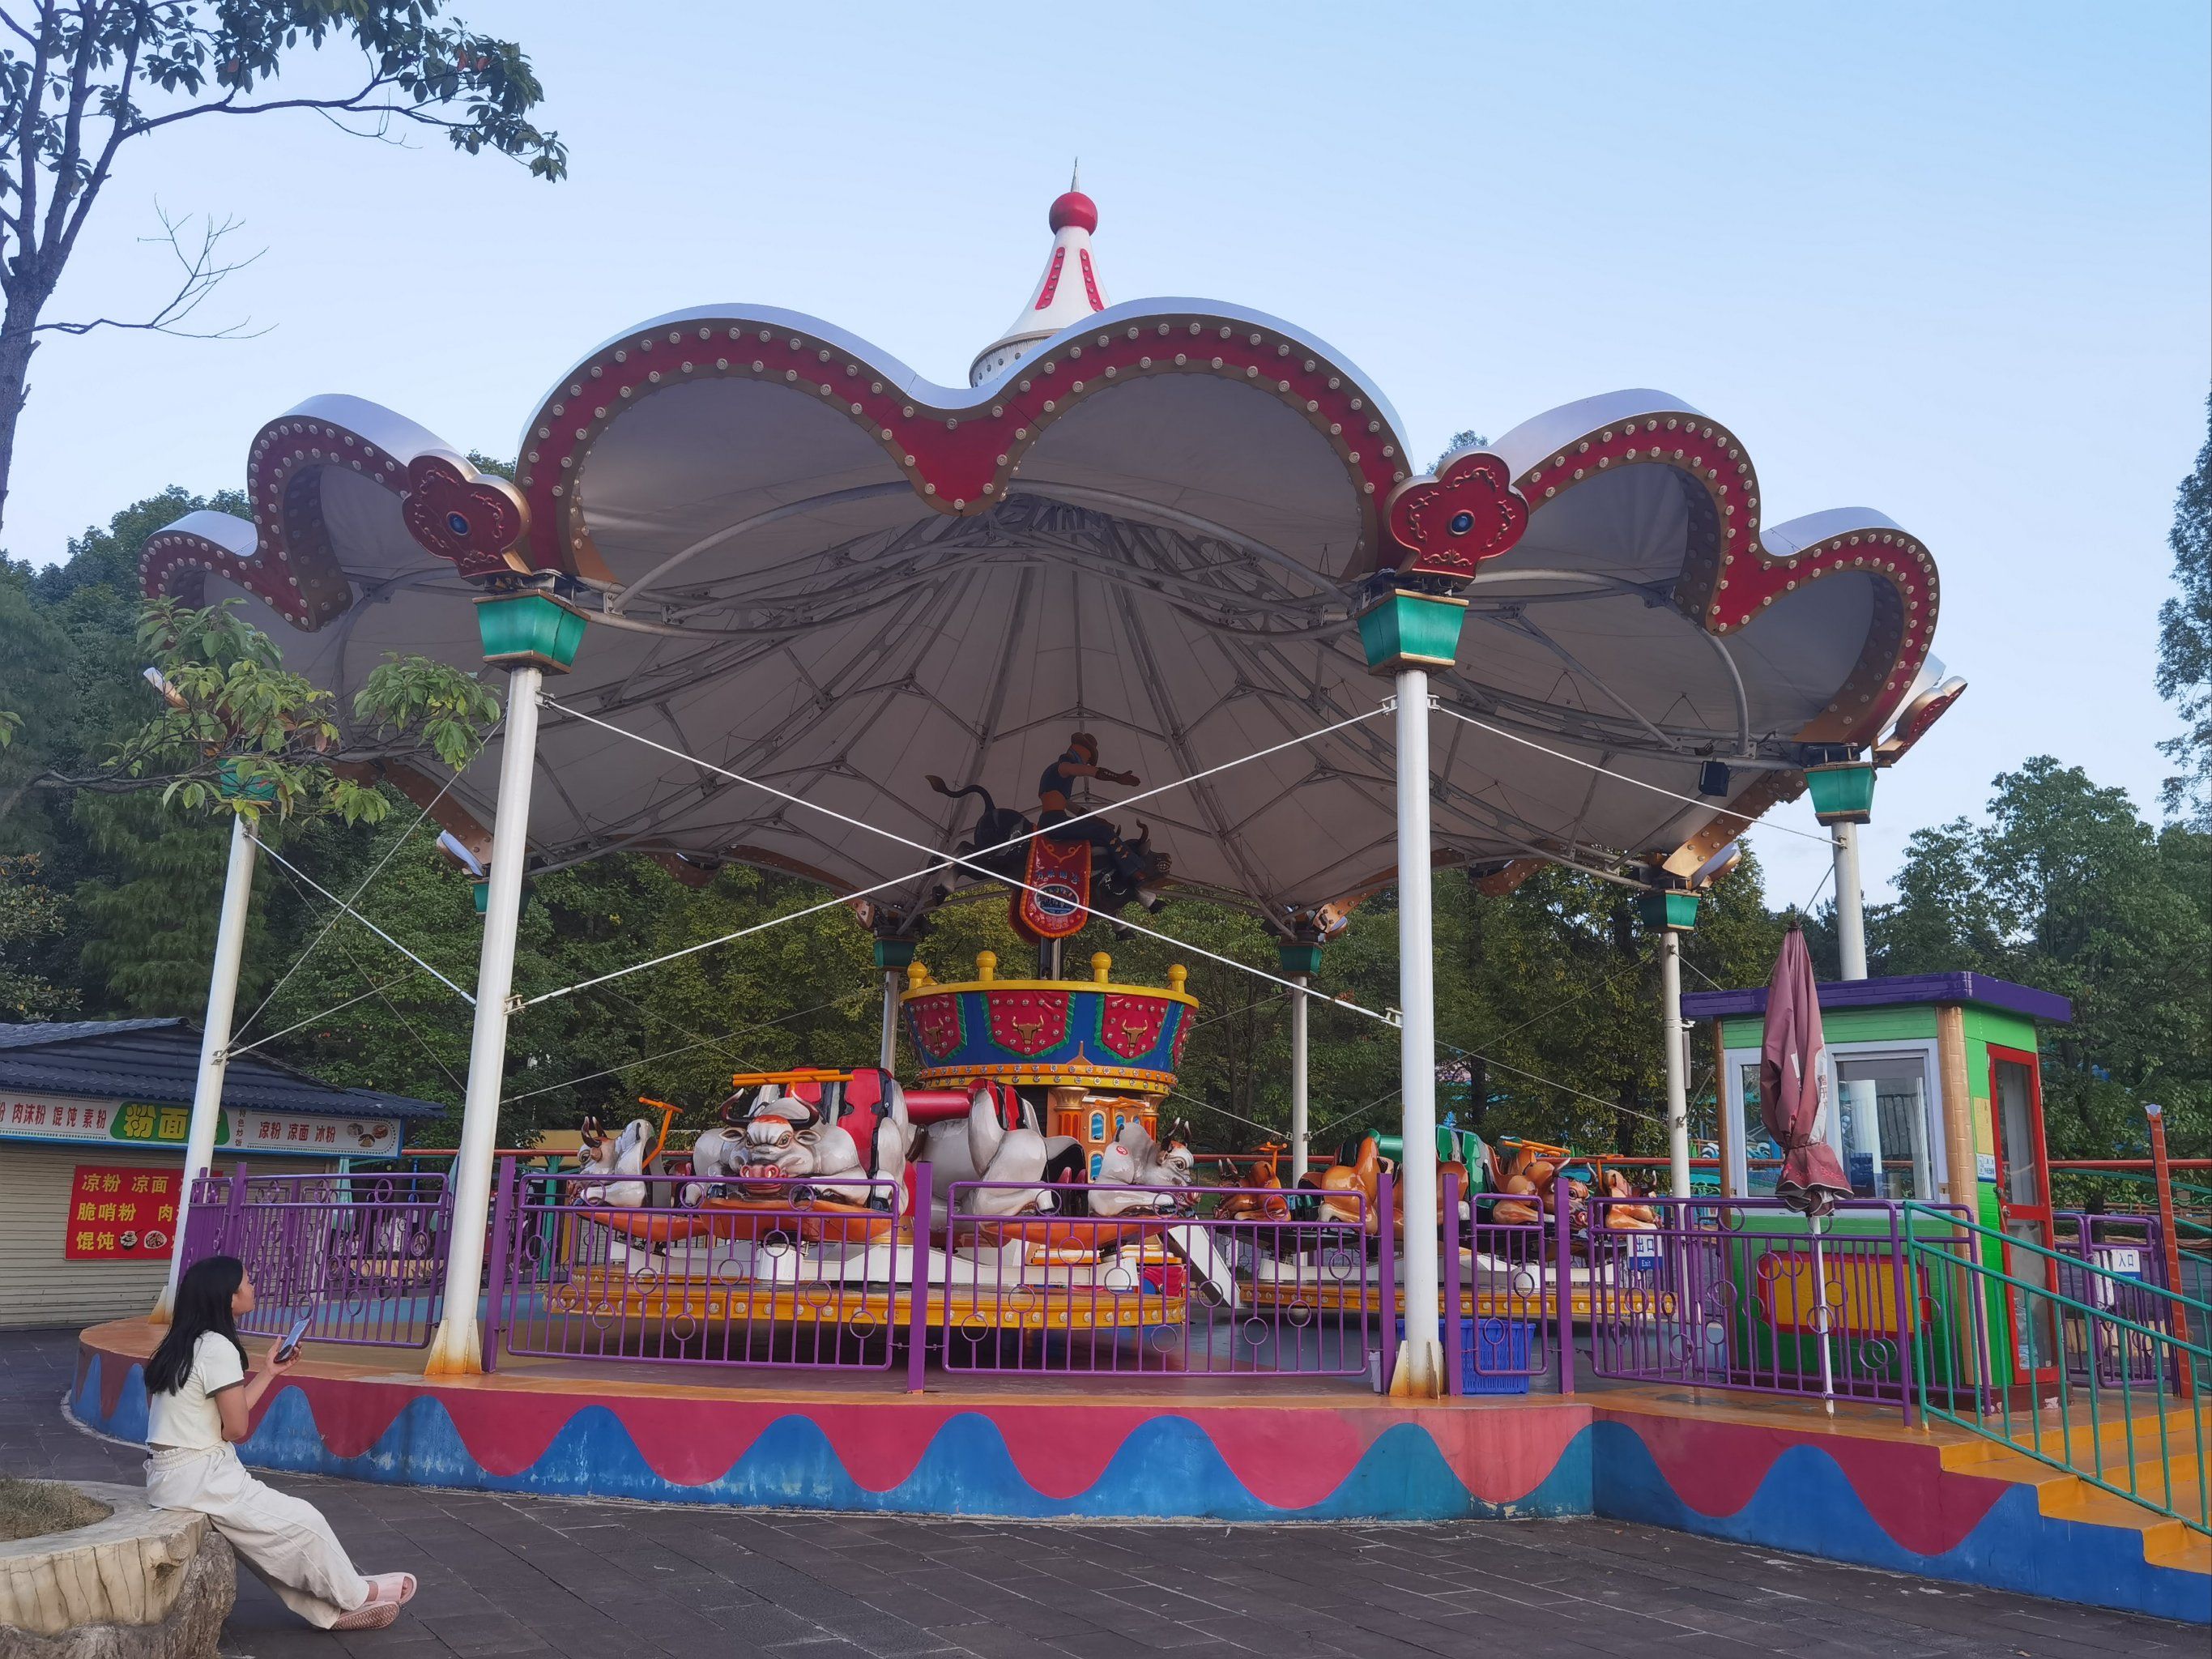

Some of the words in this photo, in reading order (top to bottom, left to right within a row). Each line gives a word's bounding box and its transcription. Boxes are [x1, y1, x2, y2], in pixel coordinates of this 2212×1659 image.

[12, 1102, 46, 1125] 肉沫粉
[52, 1107, 79, 1128] 馄饨
[83, 1109, 107, 1129] 素粉
[258, 1121, 281, 1141] 凉粉
[287, 1124, 309, 1141] 凉面
[314, 1125, 336, 1144] 冰粉
[81, 1173, 121, 1192] 凉粉
[131, 1175, 169, 1194] 凉面
[76, 1202, 137, 1222] 脆哨粉
[76, 1231, 115, 1251] 馄饨
[1641, 1259, 1652, 1267] Exit
[2118, 1252, 2134, 1268] 入口
